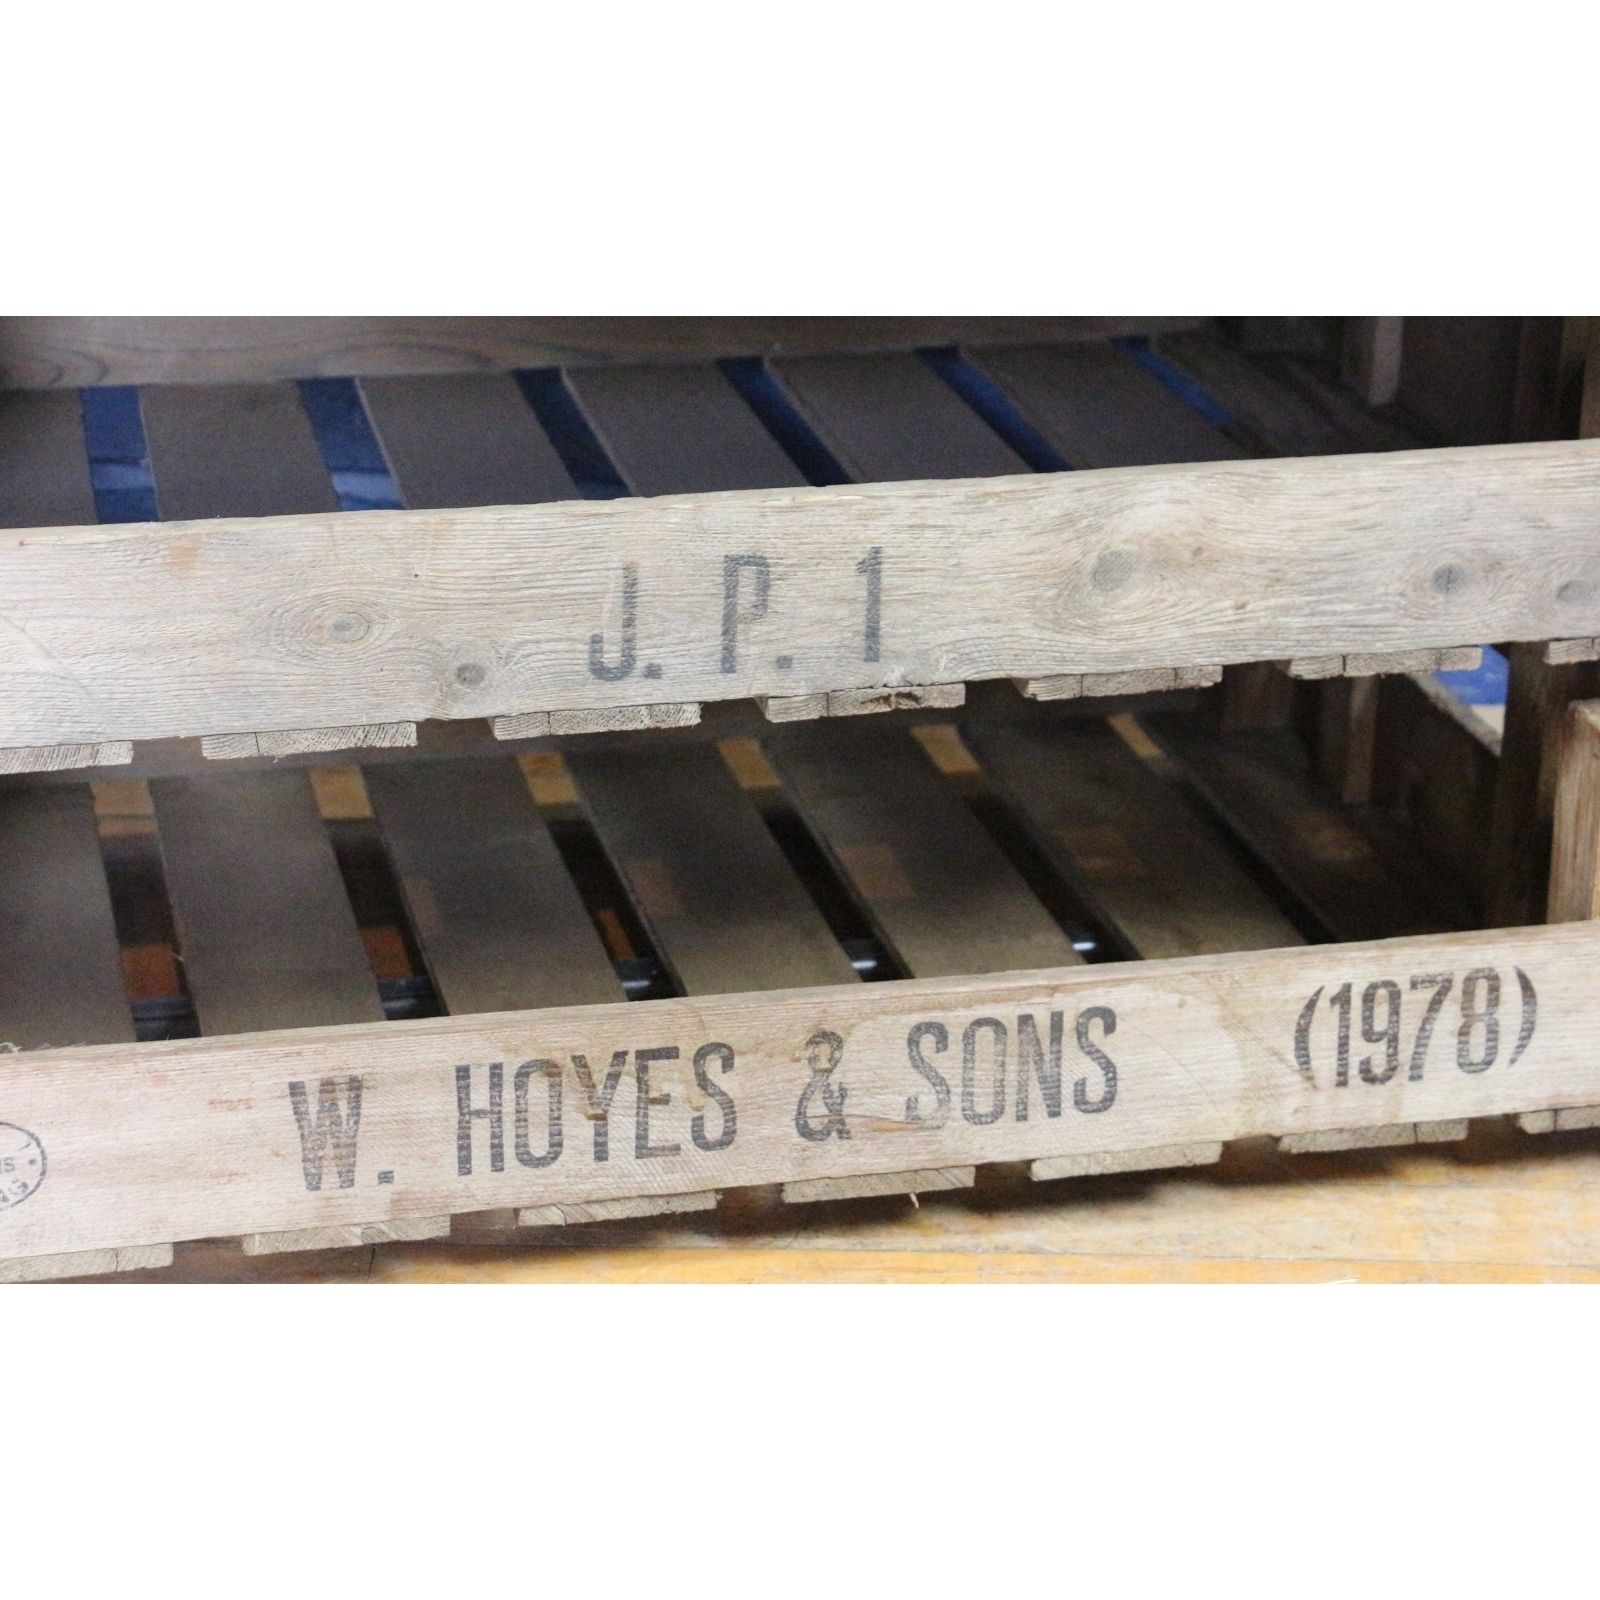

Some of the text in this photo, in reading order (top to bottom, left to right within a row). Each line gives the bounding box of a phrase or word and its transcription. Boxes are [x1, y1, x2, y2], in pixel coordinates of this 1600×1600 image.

[588, 546, 882, 682] J. P. 1
[288, 965, 1537, 1191] W. HOYES & SONS (1978)
